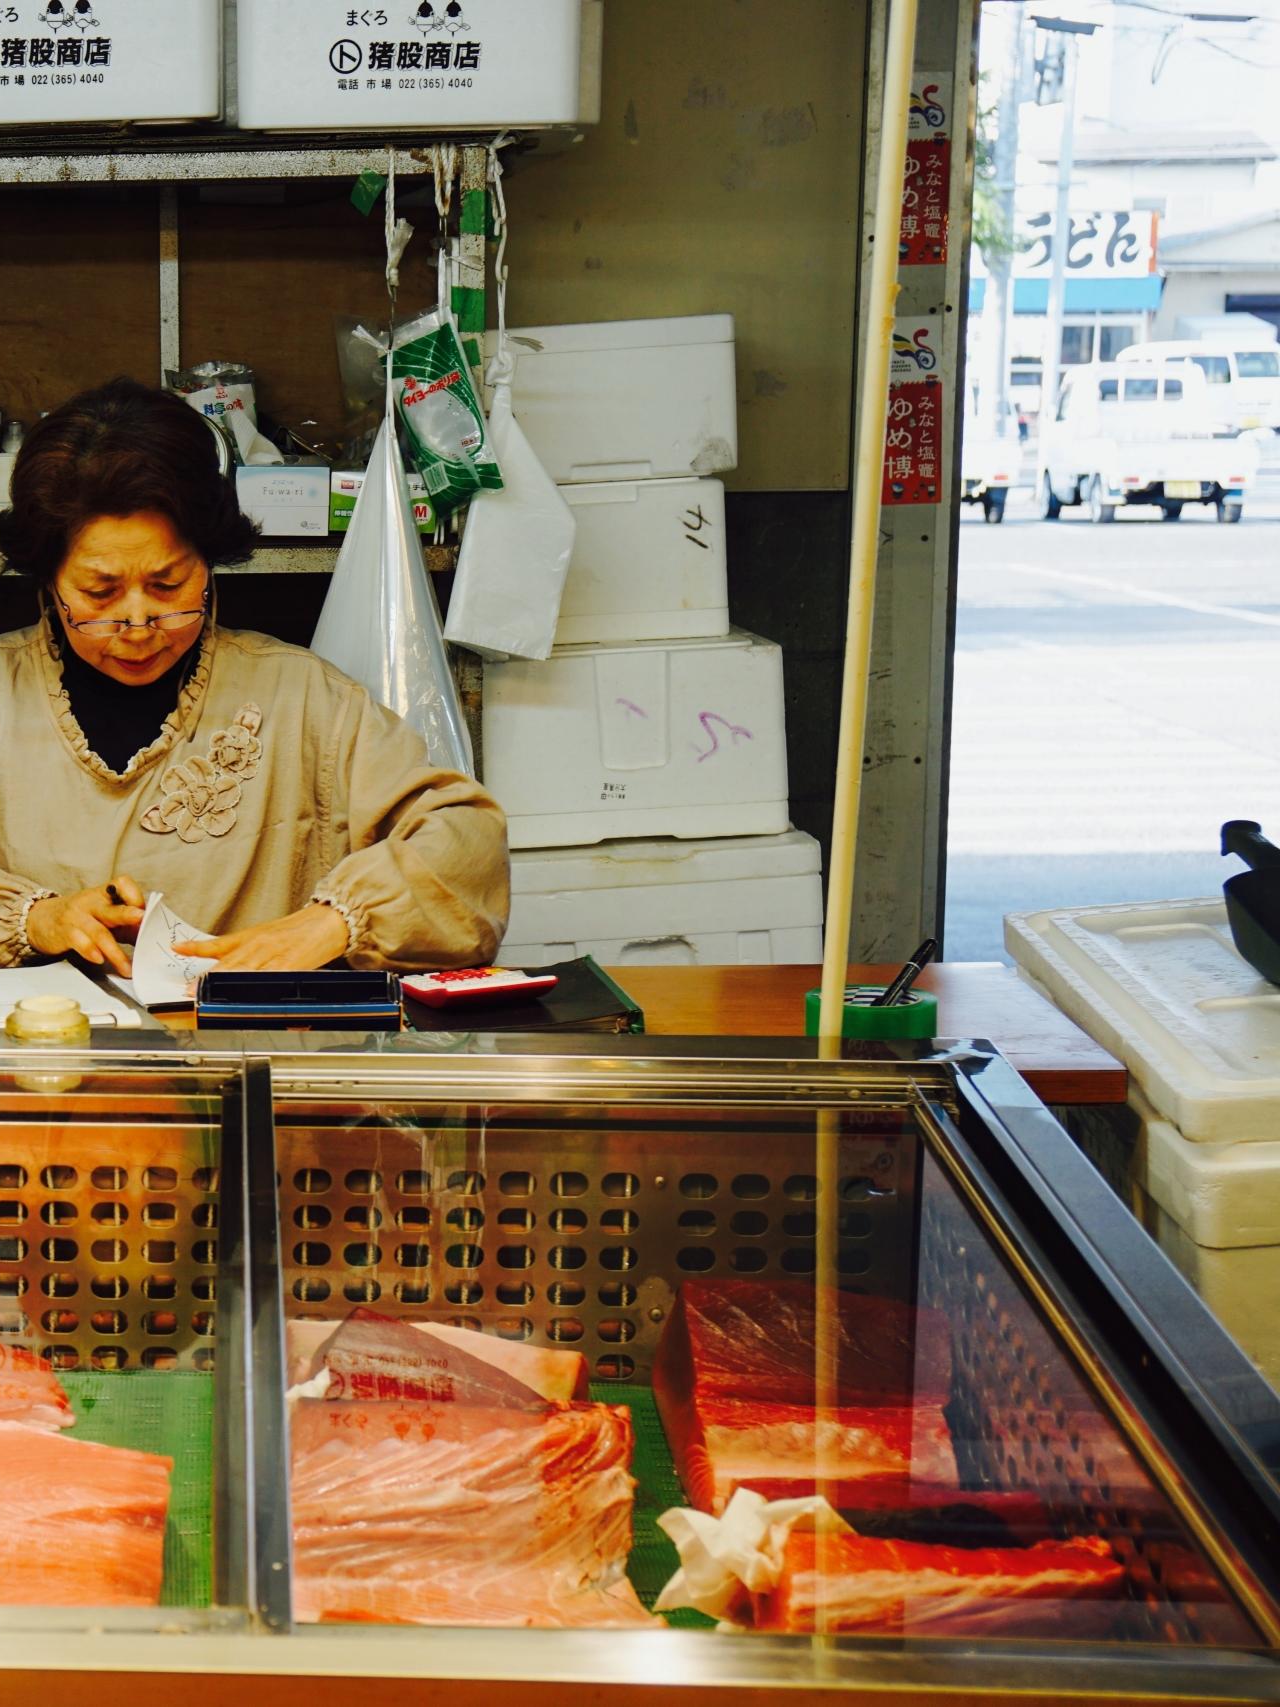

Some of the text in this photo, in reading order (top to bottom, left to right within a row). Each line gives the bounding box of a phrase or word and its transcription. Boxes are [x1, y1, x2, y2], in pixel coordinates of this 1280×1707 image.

[346, 9, 388, 27] まぐろ
[0, 36, 112, 68] 猪股商店
[368, 41, 482, 72] 猪股商店
[337, 79, 359, 91] 電話
[1024, 211, 1140, 269] うどん
[415, 506, 427, 518] M
